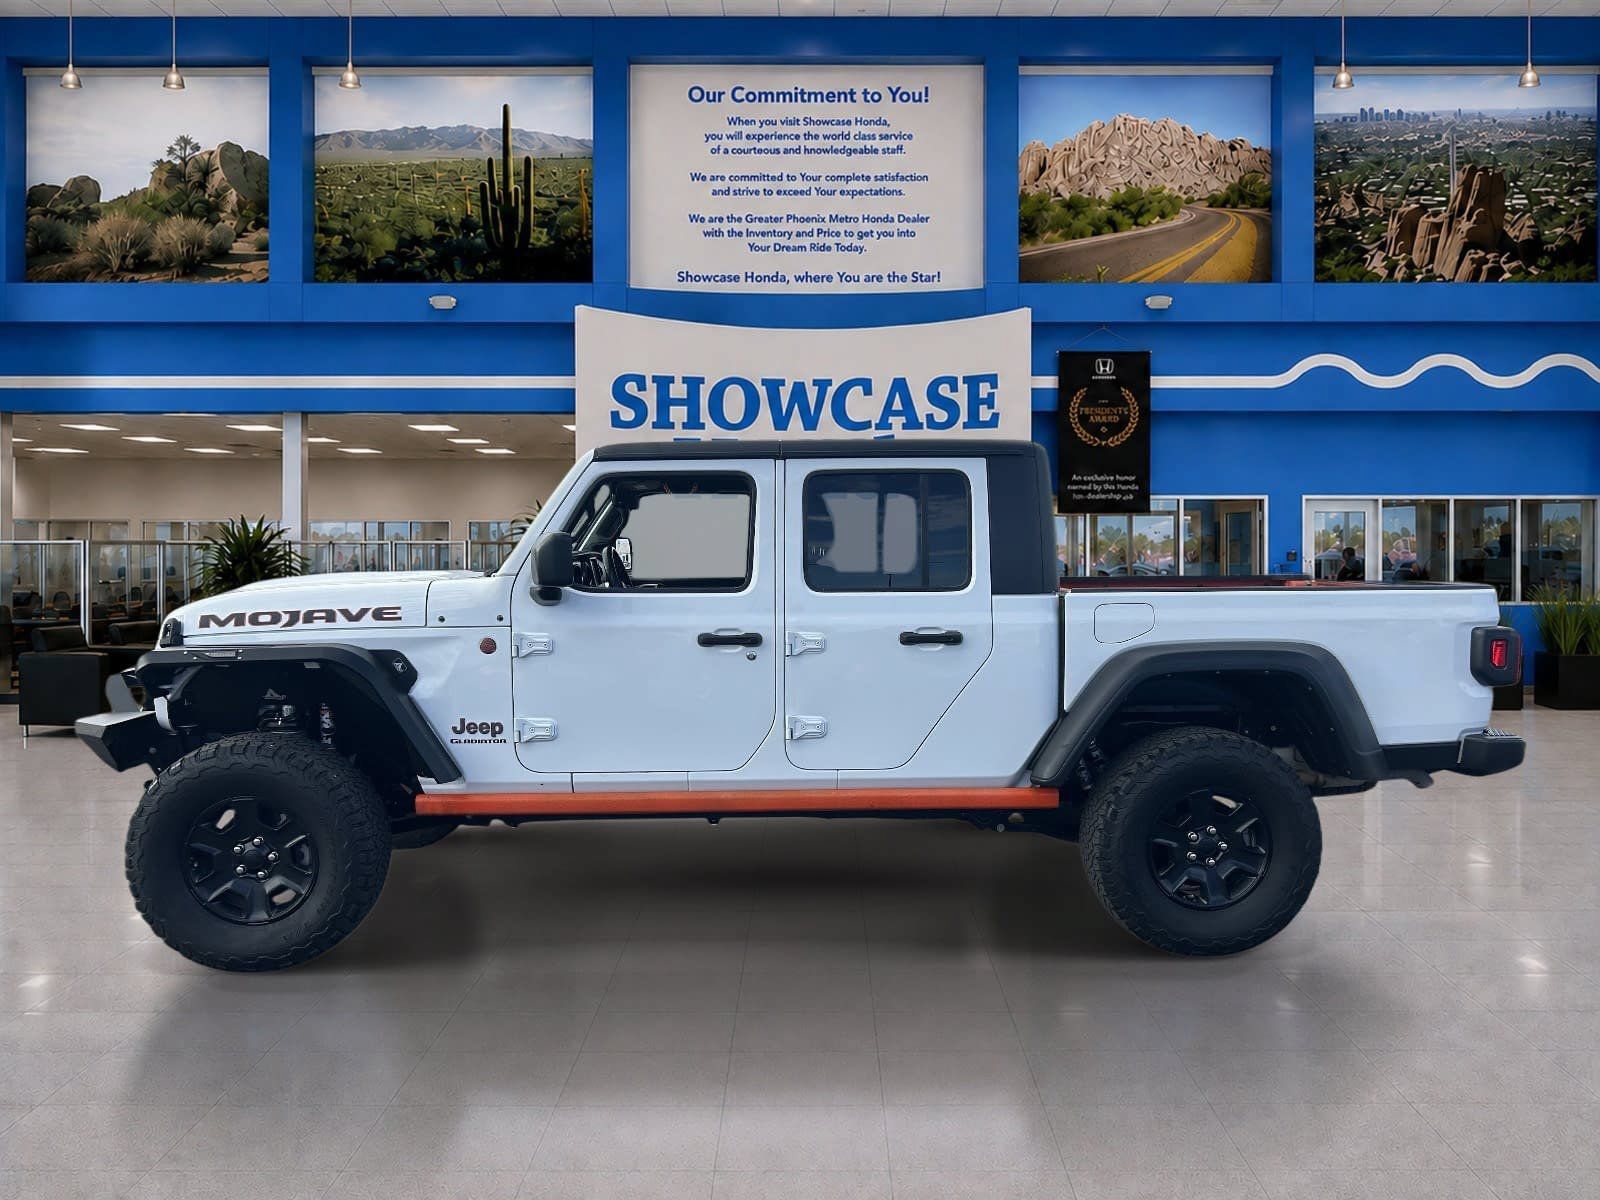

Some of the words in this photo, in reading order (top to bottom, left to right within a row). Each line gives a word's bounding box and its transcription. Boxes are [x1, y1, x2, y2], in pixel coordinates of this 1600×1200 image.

[687, 85, 727, 104] Our
[730, 85, 858, 104] Commitment
[860, 87, 883, 104] to
[886, 85, 930, 104] You!
[726, 115, 757, 127] When
[758, 118, 778, 129] you
[779, 116, 801, 127] visit
[802, 115, 853, 127] Showcase
[854, 116, 891, 128] Honda,
[704, 132, 724, 144] you
[724, 130, 744, 141] will
[744, 130, 802, 144] experience
[802, 130, 821, 142] the
[821, 130, 852, 142] world
[852, 130, 877, 142] class
[878, 130, 914, 142] service
[709, 144, 722, 155] of
[722, 147, 730, 155] a
[730, 146, 782, 156] courteous
[782, 144, 802, 155] and
[881, 143, 907, 156] staff.
[689, 171, 708, 183] We
[709, 174, 727, 182] are
[727, 171, 784, 183] committed
[785, 173, 798, 183] to
[799, 172, 823, 183] Your
[824, 172, 872, 185] complete
[873, 171, 929, 183] satisfaction
[711, 185, 731, 197] and
[731, 186, 761, 197] strive
[762, 187, 774, 197] to
[775, 185, 812, 197] exceed
[813, 186, 838, 197] Your
[838, 186, 906, 200] expectations.
[688, 213, 706, 224] We
[707, 215, 725, 224] are
[725, 213, 743, 224] the
[744, 213, 785, 224] Greater
[785, 213, 827, 224] Phoenix
[828, 213, 860, 224] Metro
[861, 213, 896, 224] Honda
[897, 213, 931, 224] Dealer
[702, 227, 725, 238] with
[726, 227, 744, 239] the
[745, 227, 794, 241] Inventory
[794, 227, 815, 239] and
[816, 227, 842, 239] Price
[843, 229, 856, 239] to
[856, 229, 875, 241] get
[875, 230, 895, 241] you
[896, 227, 917, 238] into
[747, 241, 772, 253] Your
[772, 242, 808, 253] Dream
[809, 242, 833, 253] Ride
[833, 242, 868, 255] Today.
[676, 270, 741, 284] Showcase
[744, 270, 790, 286] Honda,
[793, 270, 834, 284] where
[836, 271, 861, 284] You
[863, 274, 884, 284] are
[886, 270, 908, 284] the
[910, 270, 941, 284] Star!
[609, 372, 1000, 432] SHOWCASE
[198, 606, 402, 629] MOJAVE
[451, 717, 504, 737] Jeep
